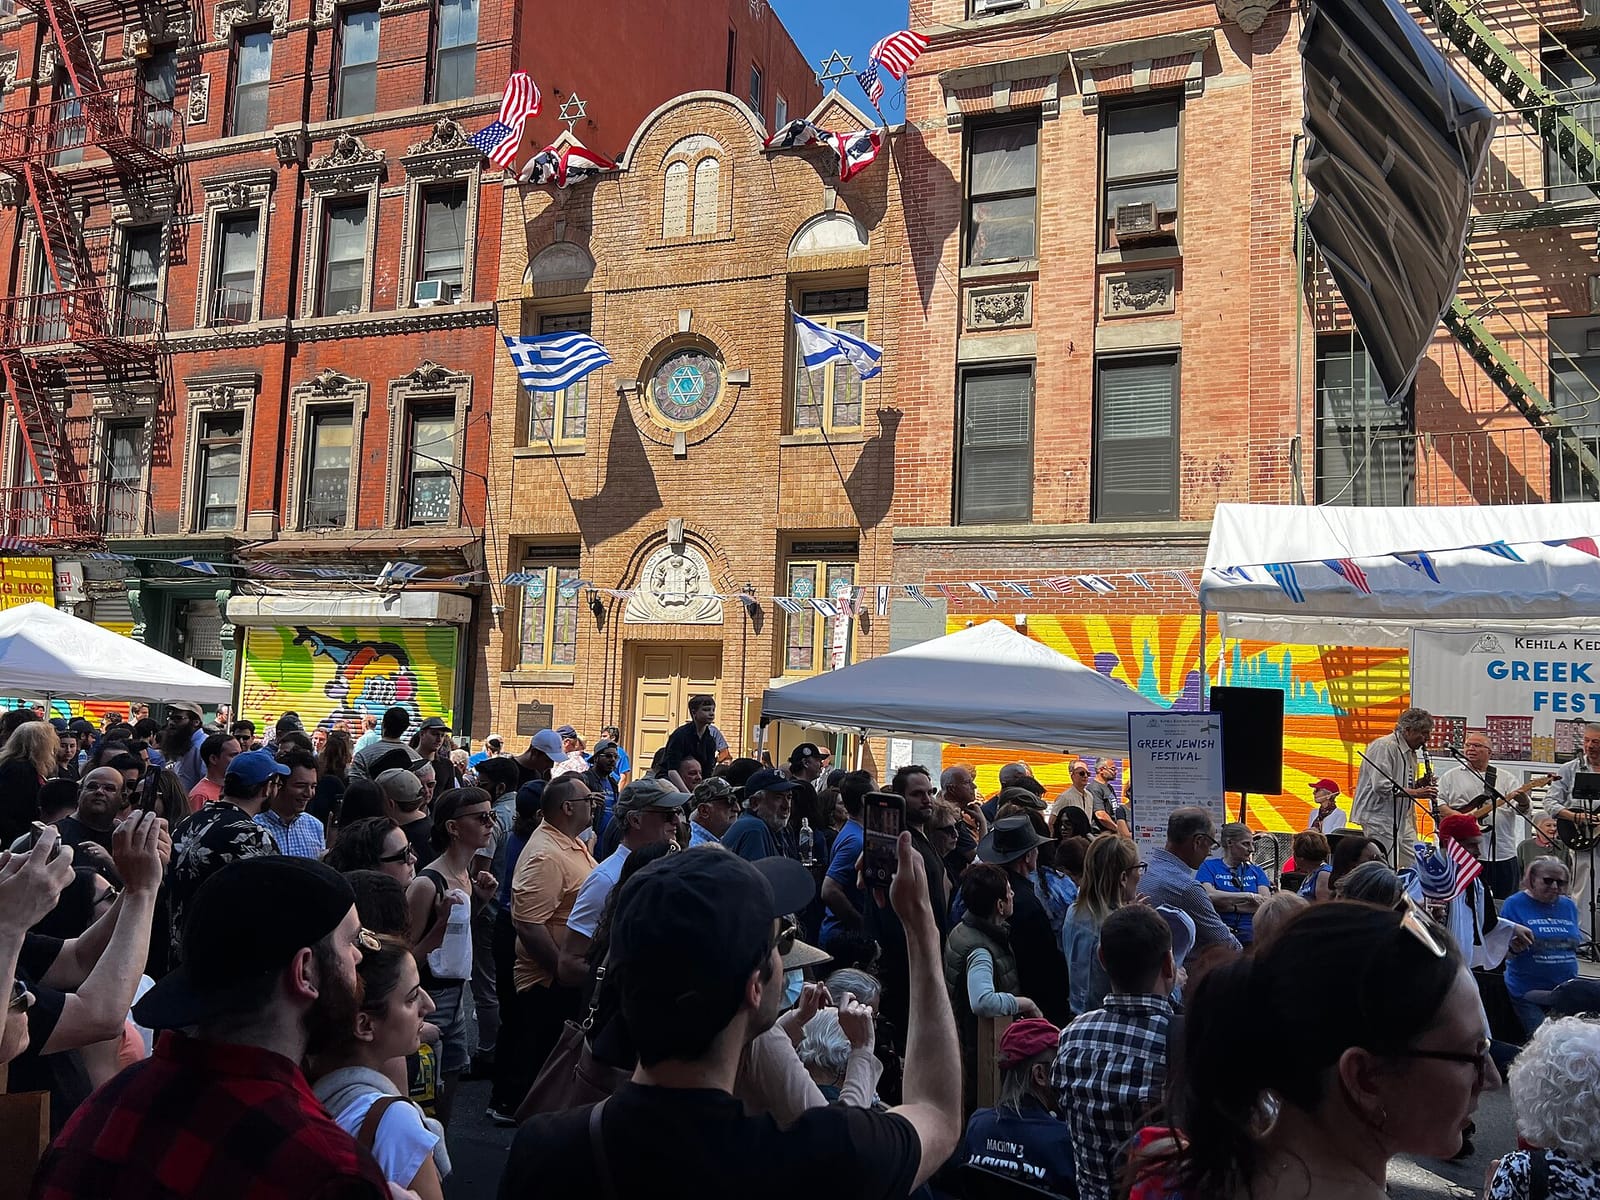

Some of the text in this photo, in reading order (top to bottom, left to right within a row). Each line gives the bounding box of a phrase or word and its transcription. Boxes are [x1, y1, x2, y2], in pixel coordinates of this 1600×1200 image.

[0, 583, 47, 594] G INC.
[1487, 660, 1595, 683] GREEK
[1533, 691, 1600, 714] FEST
[1137, 739, 1215, 749] GREEK JEWISH
[1151, 751, 1202, 762] FESTIVAL
[1016, 1144, 1025, 1159] 3
